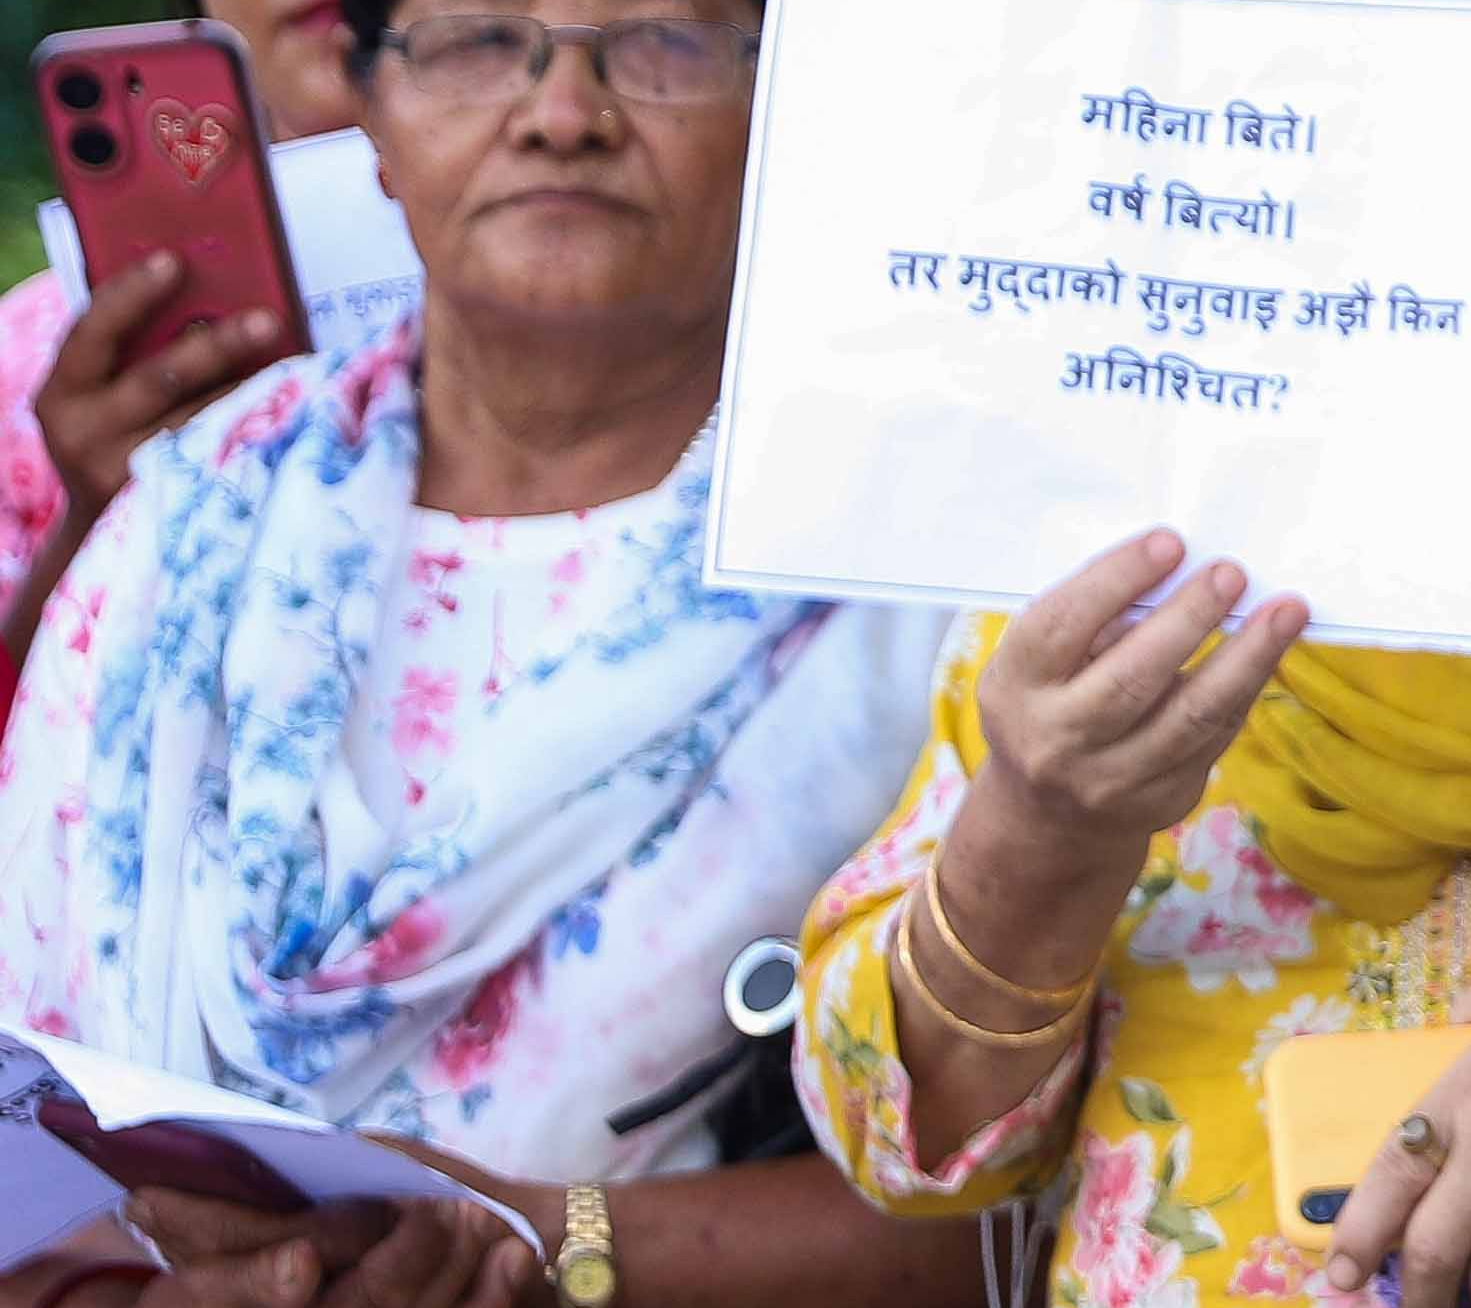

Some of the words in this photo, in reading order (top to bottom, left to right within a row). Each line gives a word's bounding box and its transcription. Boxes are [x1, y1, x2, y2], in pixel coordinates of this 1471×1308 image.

[1081, 87, 1213, 144] महिना
[1223, 99, 1316, 153] बिते।
[1089, 173, 1153, 222] वर्ष
[1162, 179, 1295, 240] बित्यो।
[888, 250, 948, 291] तर
[1137, 274, 1285, 337] सुनुवाइ
[1294, 281, 1377, 337] अझै
[1386, 283, 1465, 335] किन
[1059, 345, 1289, 411] अनिश्चित?
